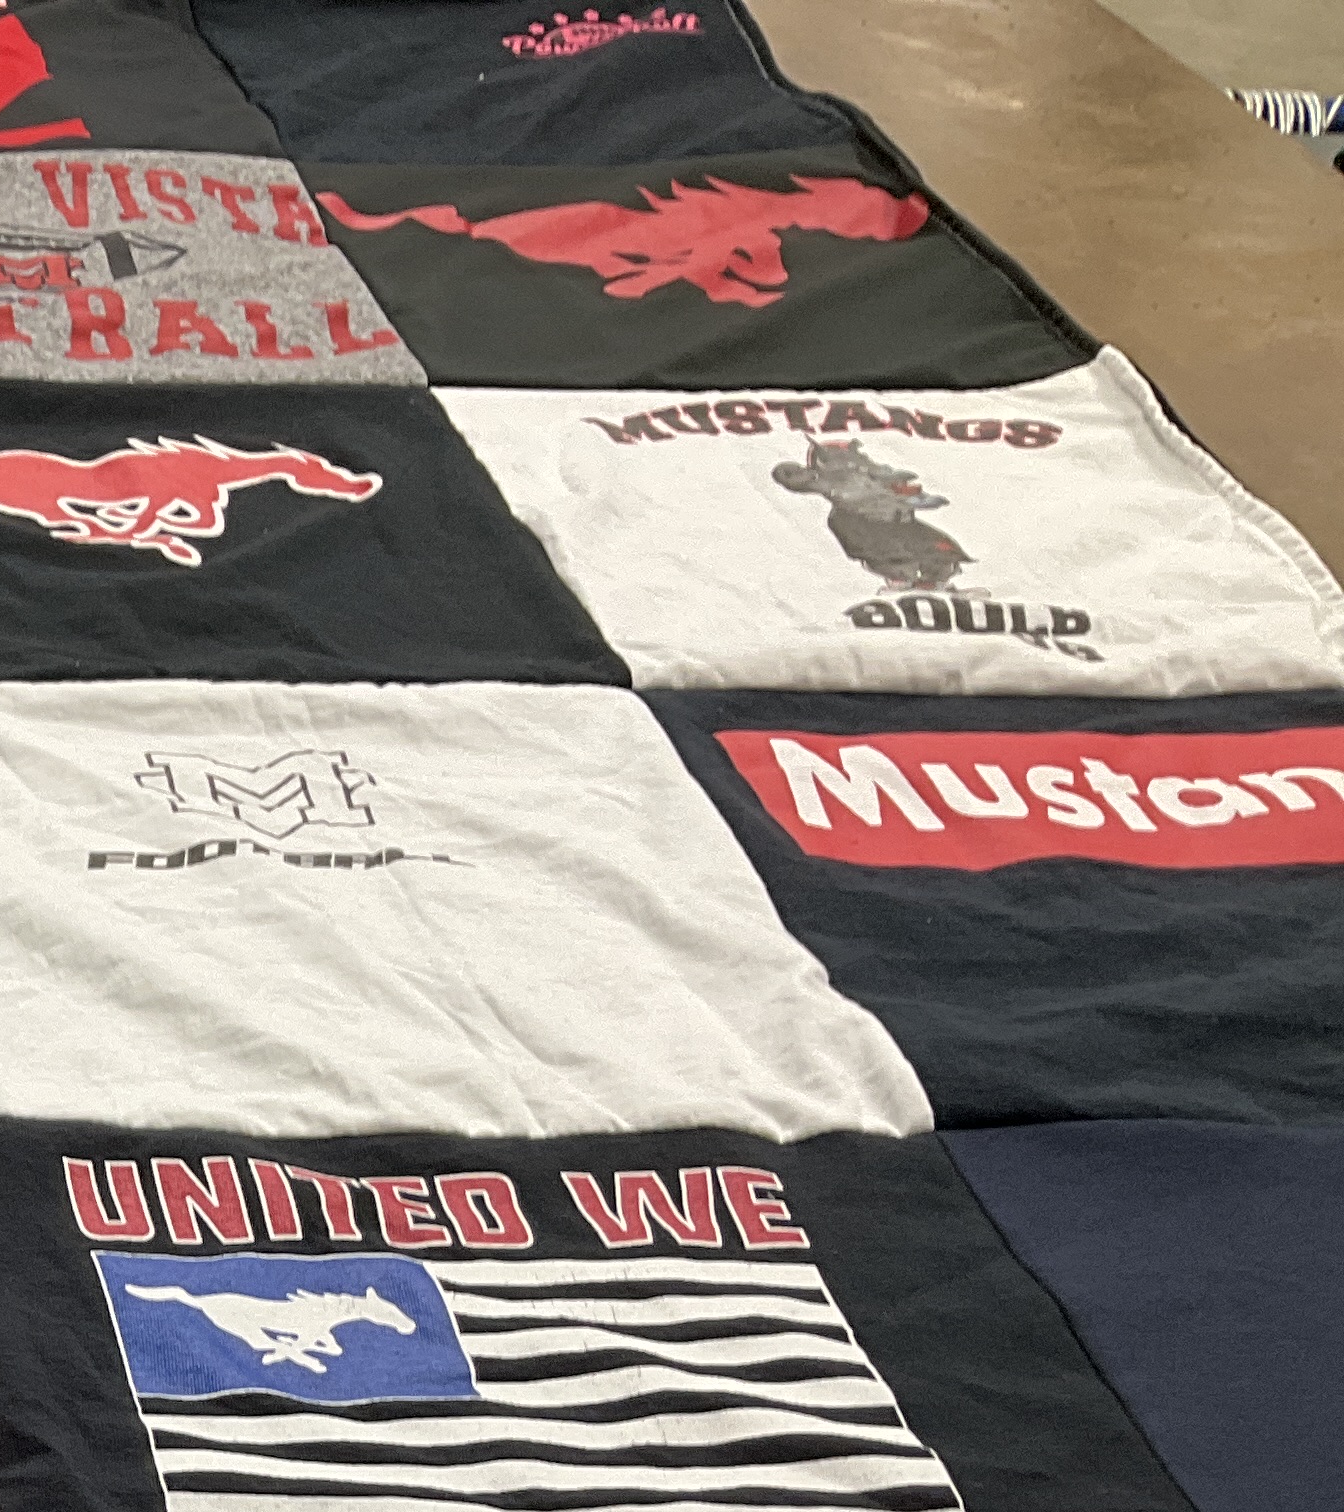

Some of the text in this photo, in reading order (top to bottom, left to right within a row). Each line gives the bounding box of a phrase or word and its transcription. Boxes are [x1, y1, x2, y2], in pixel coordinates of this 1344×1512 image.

[32, 160, 330, 248] VISTA
[580, 398, 1065, 450] MUSTANGS
[60, 1153, 812, 1251] UNITED WE
